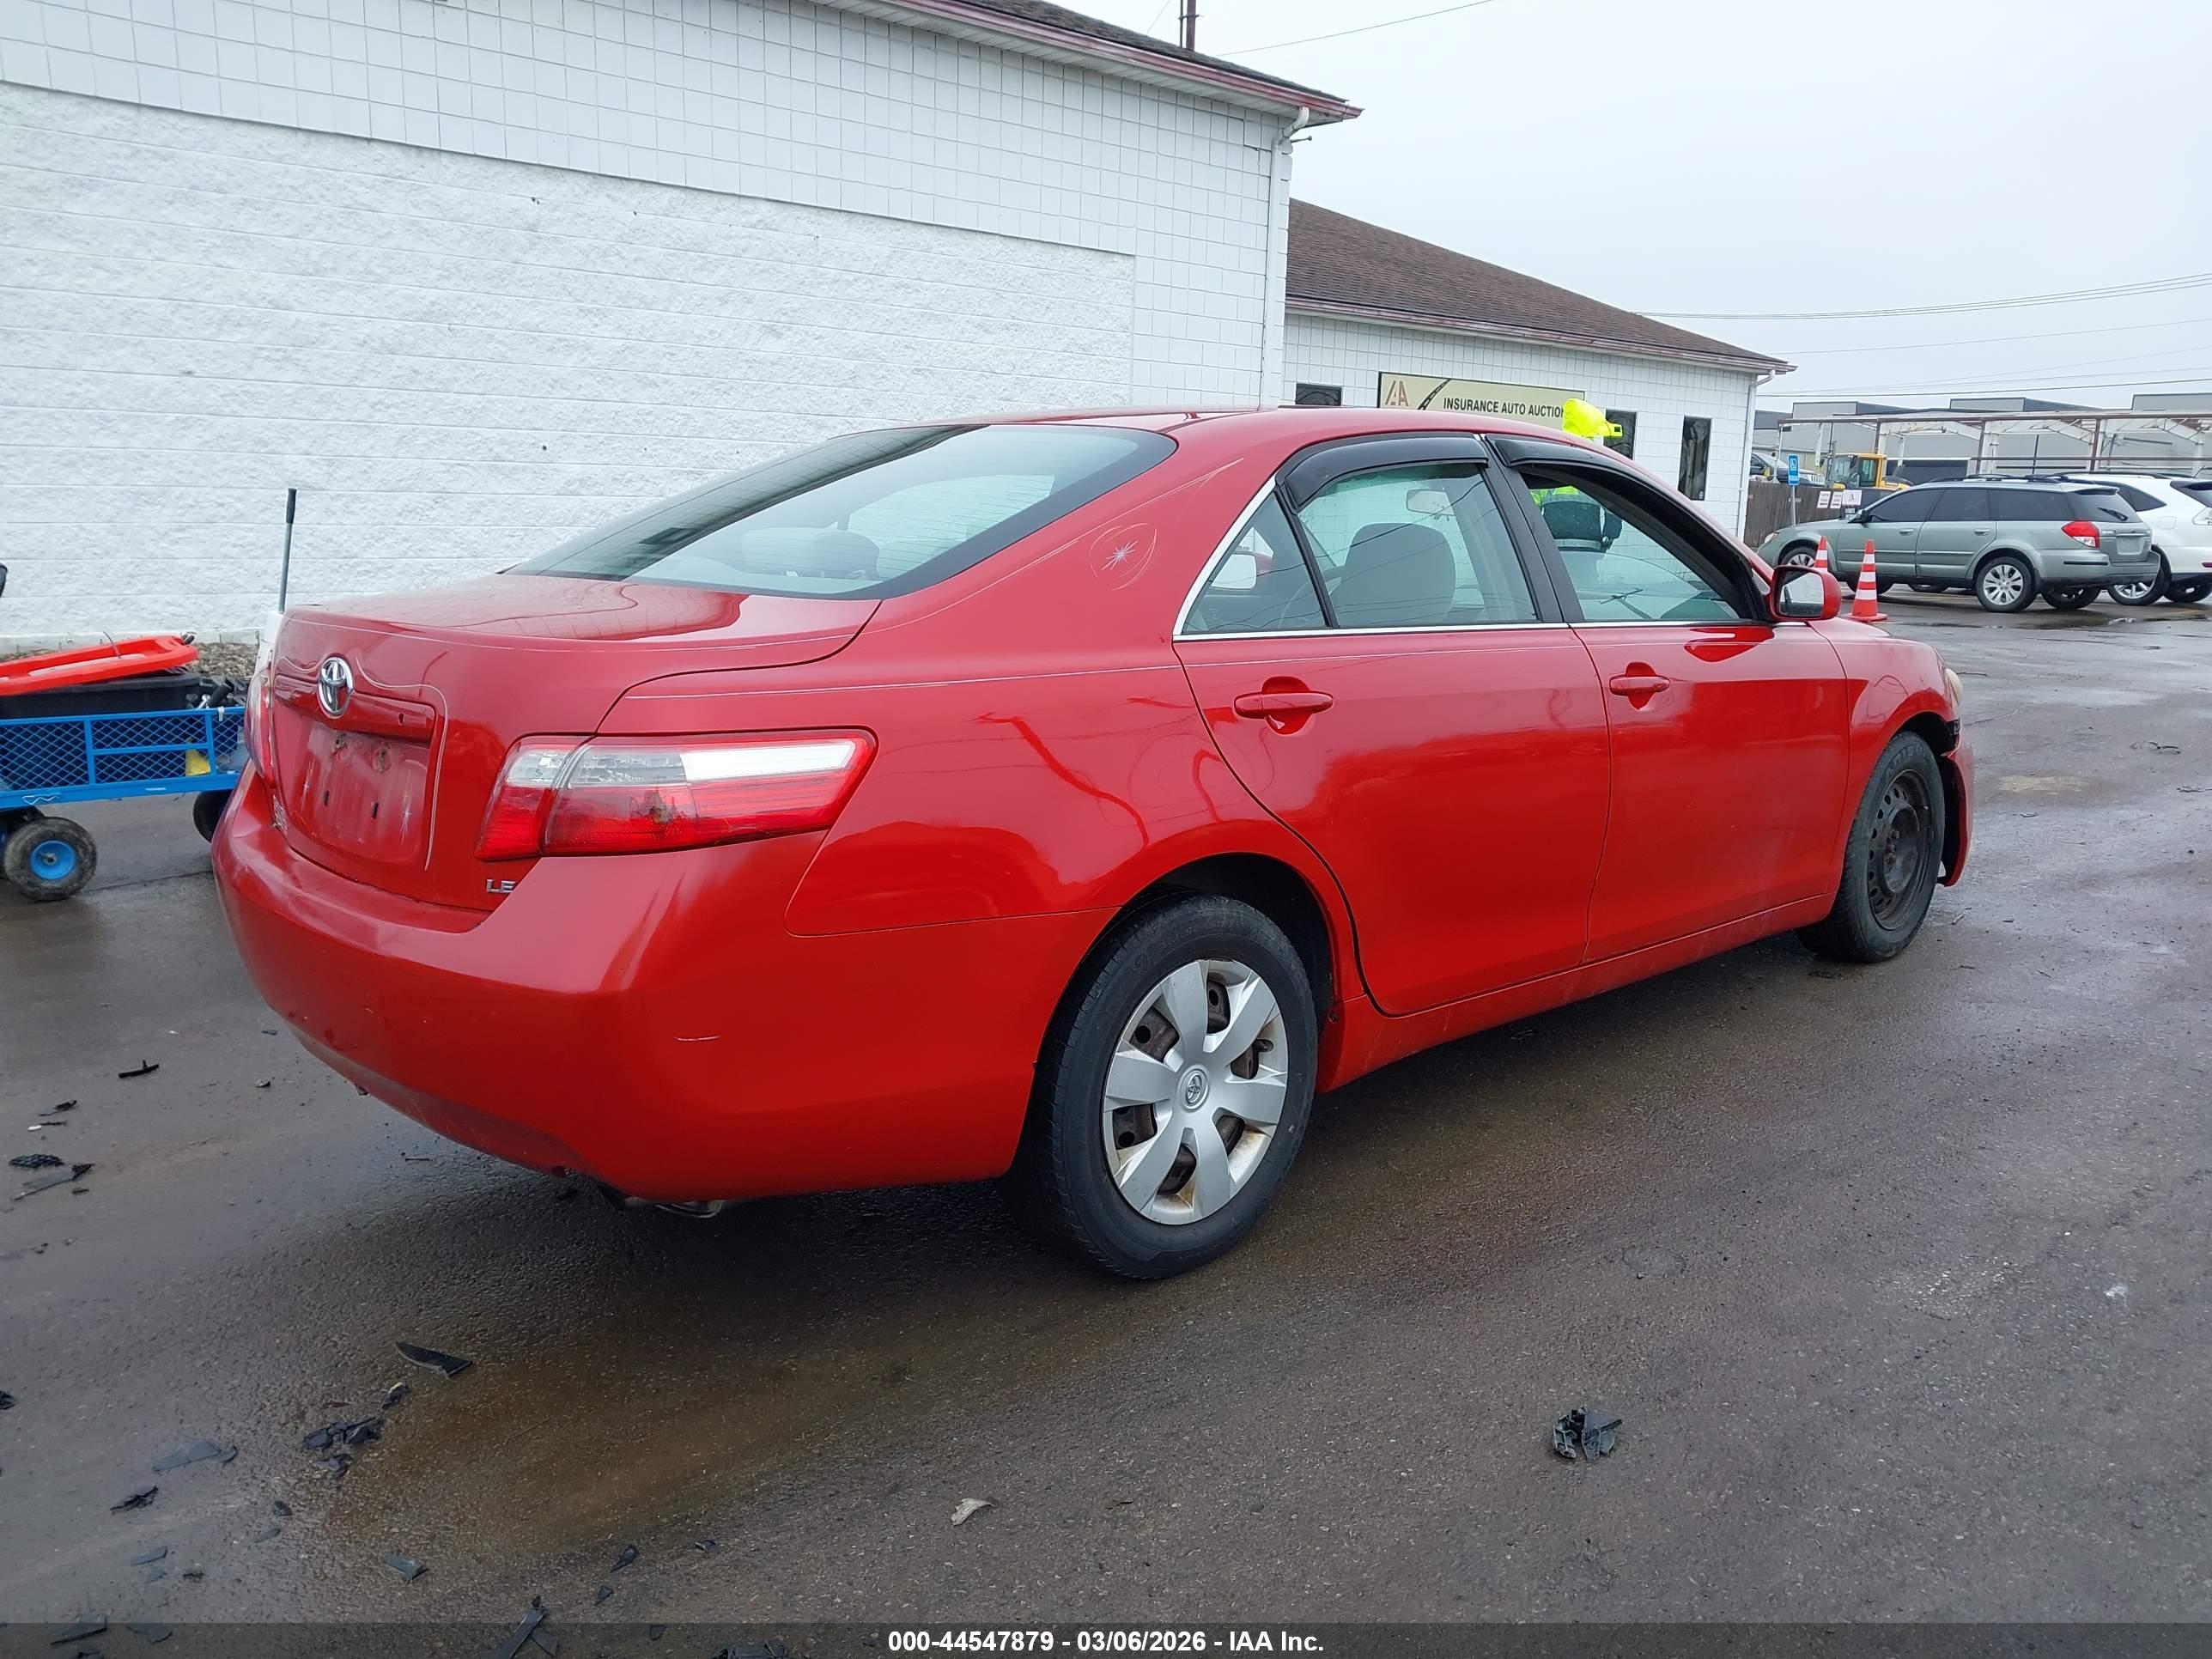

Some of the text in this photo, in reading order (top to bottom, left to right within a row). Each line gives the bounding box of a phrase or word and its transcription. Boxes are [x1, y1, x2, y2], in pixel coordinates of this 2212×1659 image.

[1443, 398, 1499, 413] INSURANCE
[1501, 402, 1526, 415] AUTO
[486, 878, 516, 893] LE
